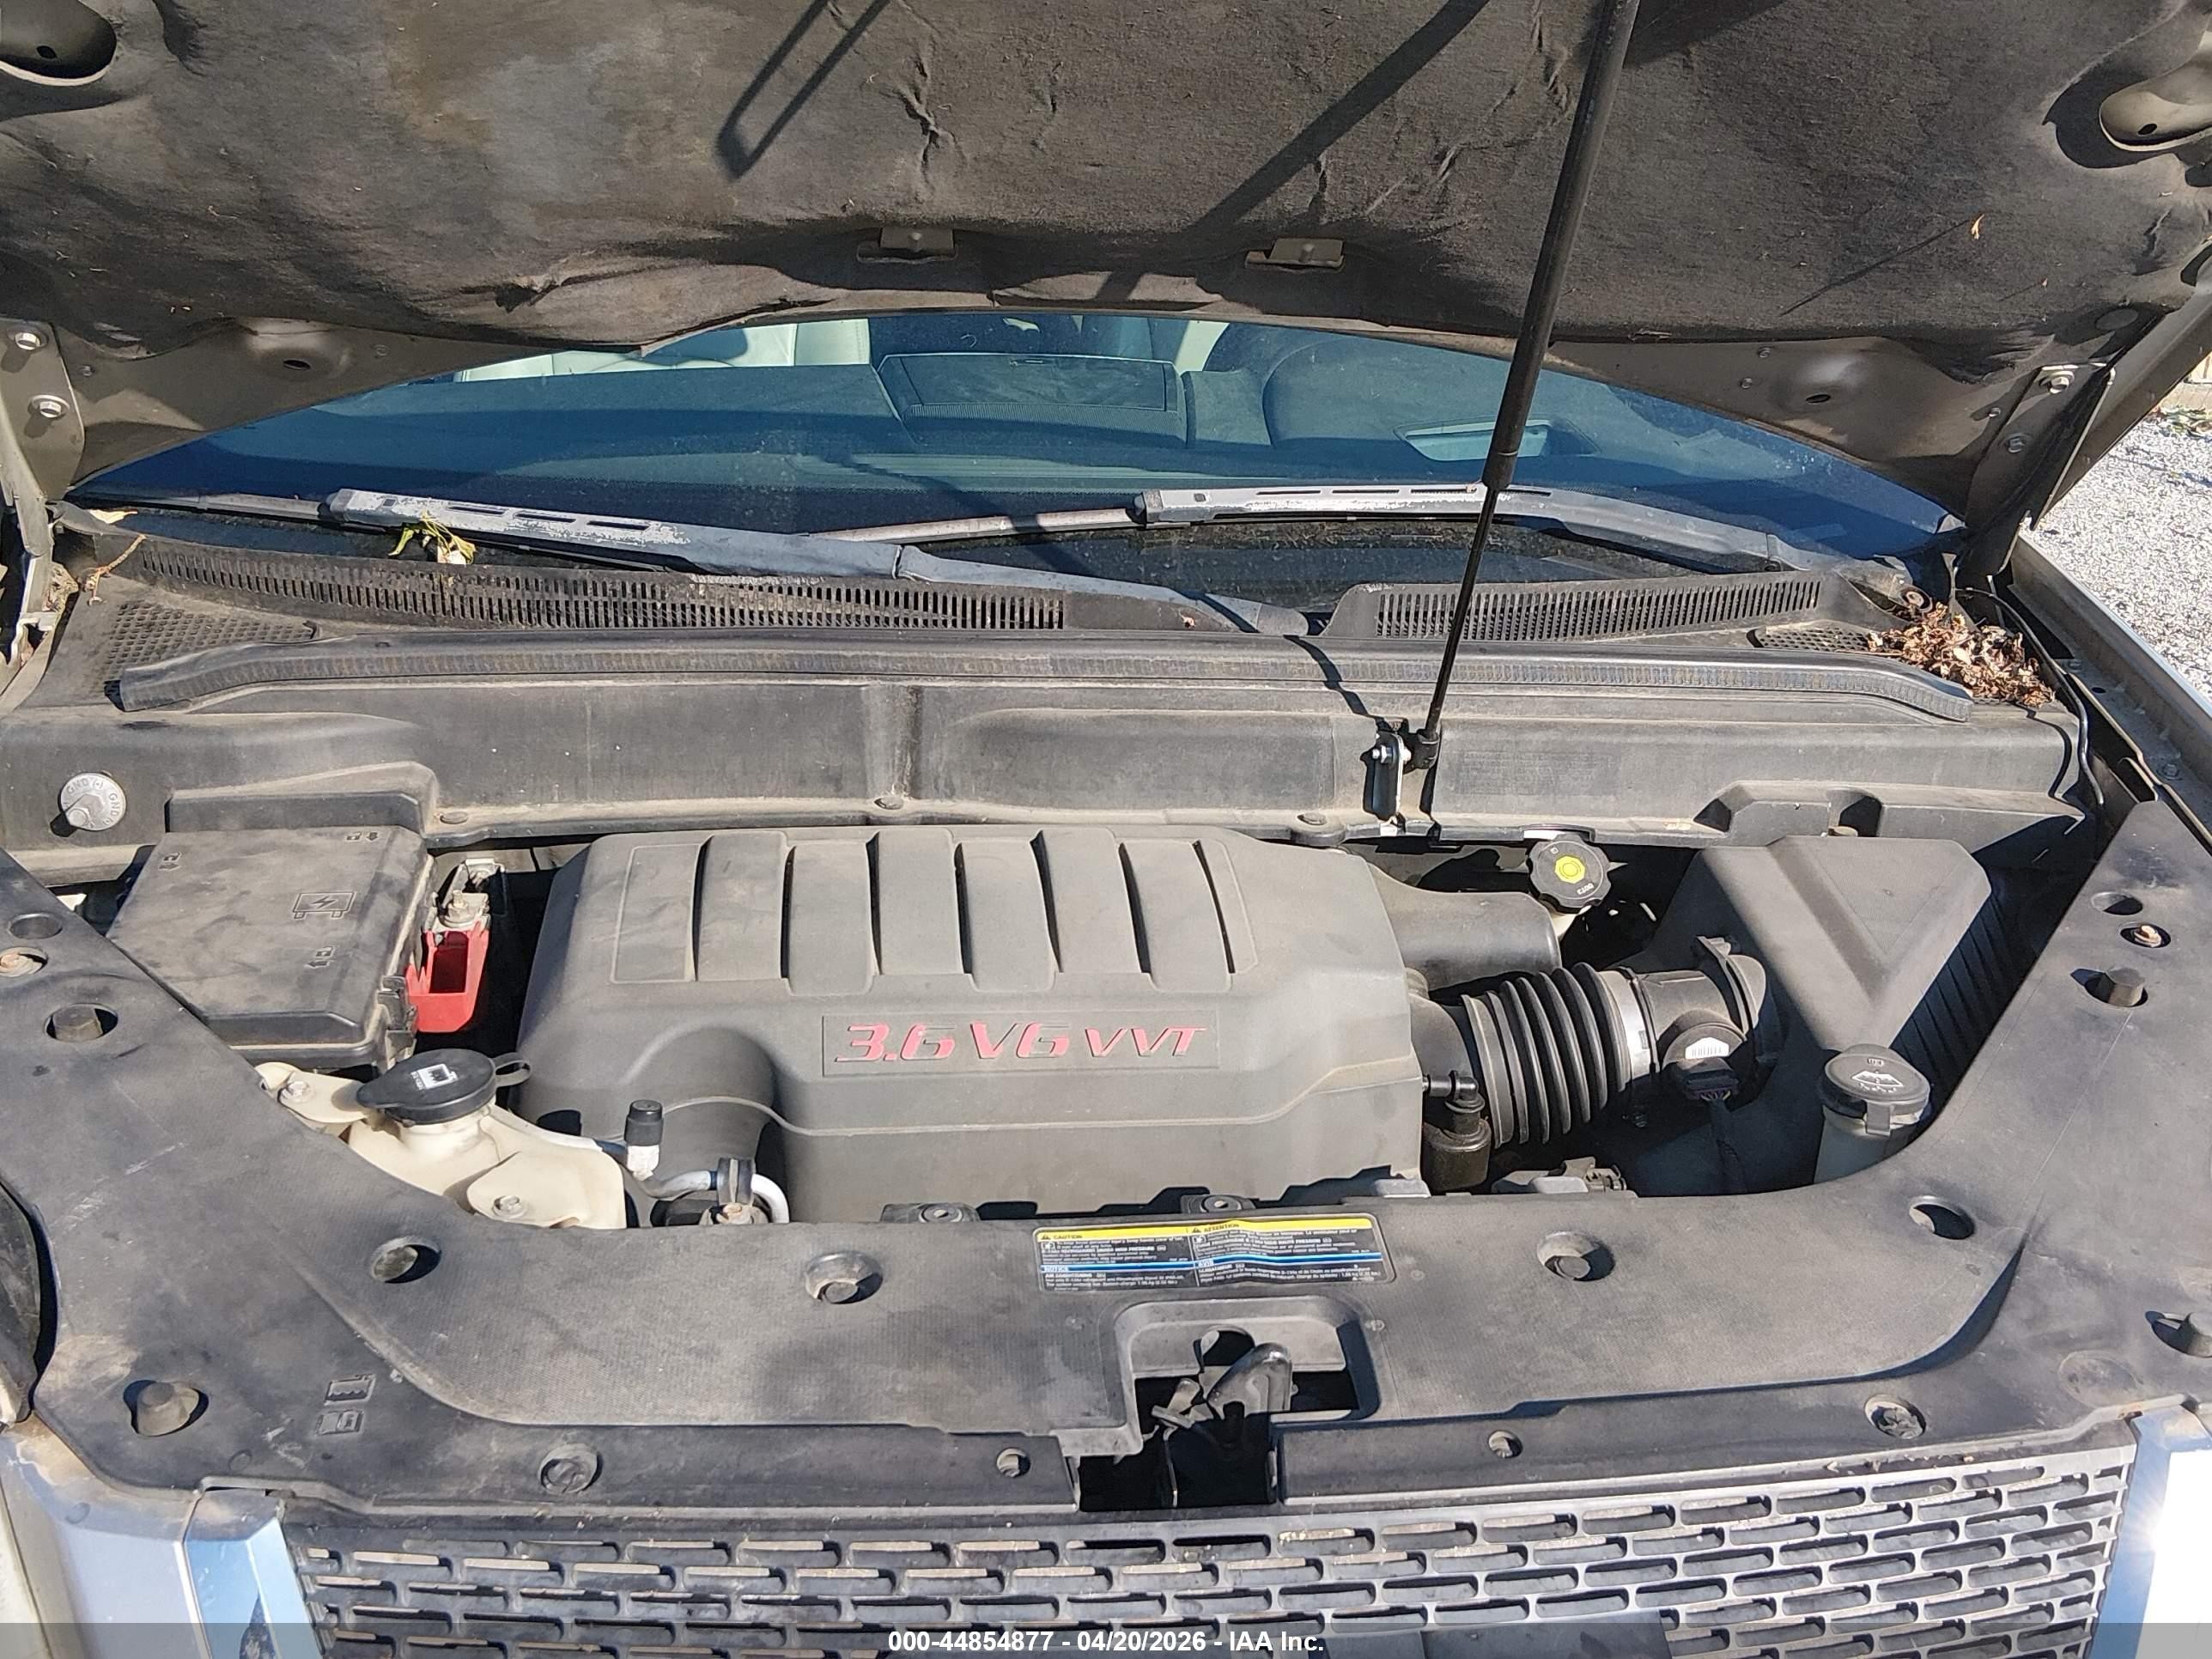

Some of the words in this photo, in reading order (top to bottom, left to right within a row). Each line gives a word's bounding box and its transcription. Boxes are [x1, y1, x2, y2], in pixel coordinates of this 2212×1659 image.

[68, 778, 88, 793] GND
[834, 1023, 957, 1062] 3.6
[969, 1022, 1071, 1060] V6
[1085, 1026, 1207, 1058] VVT
